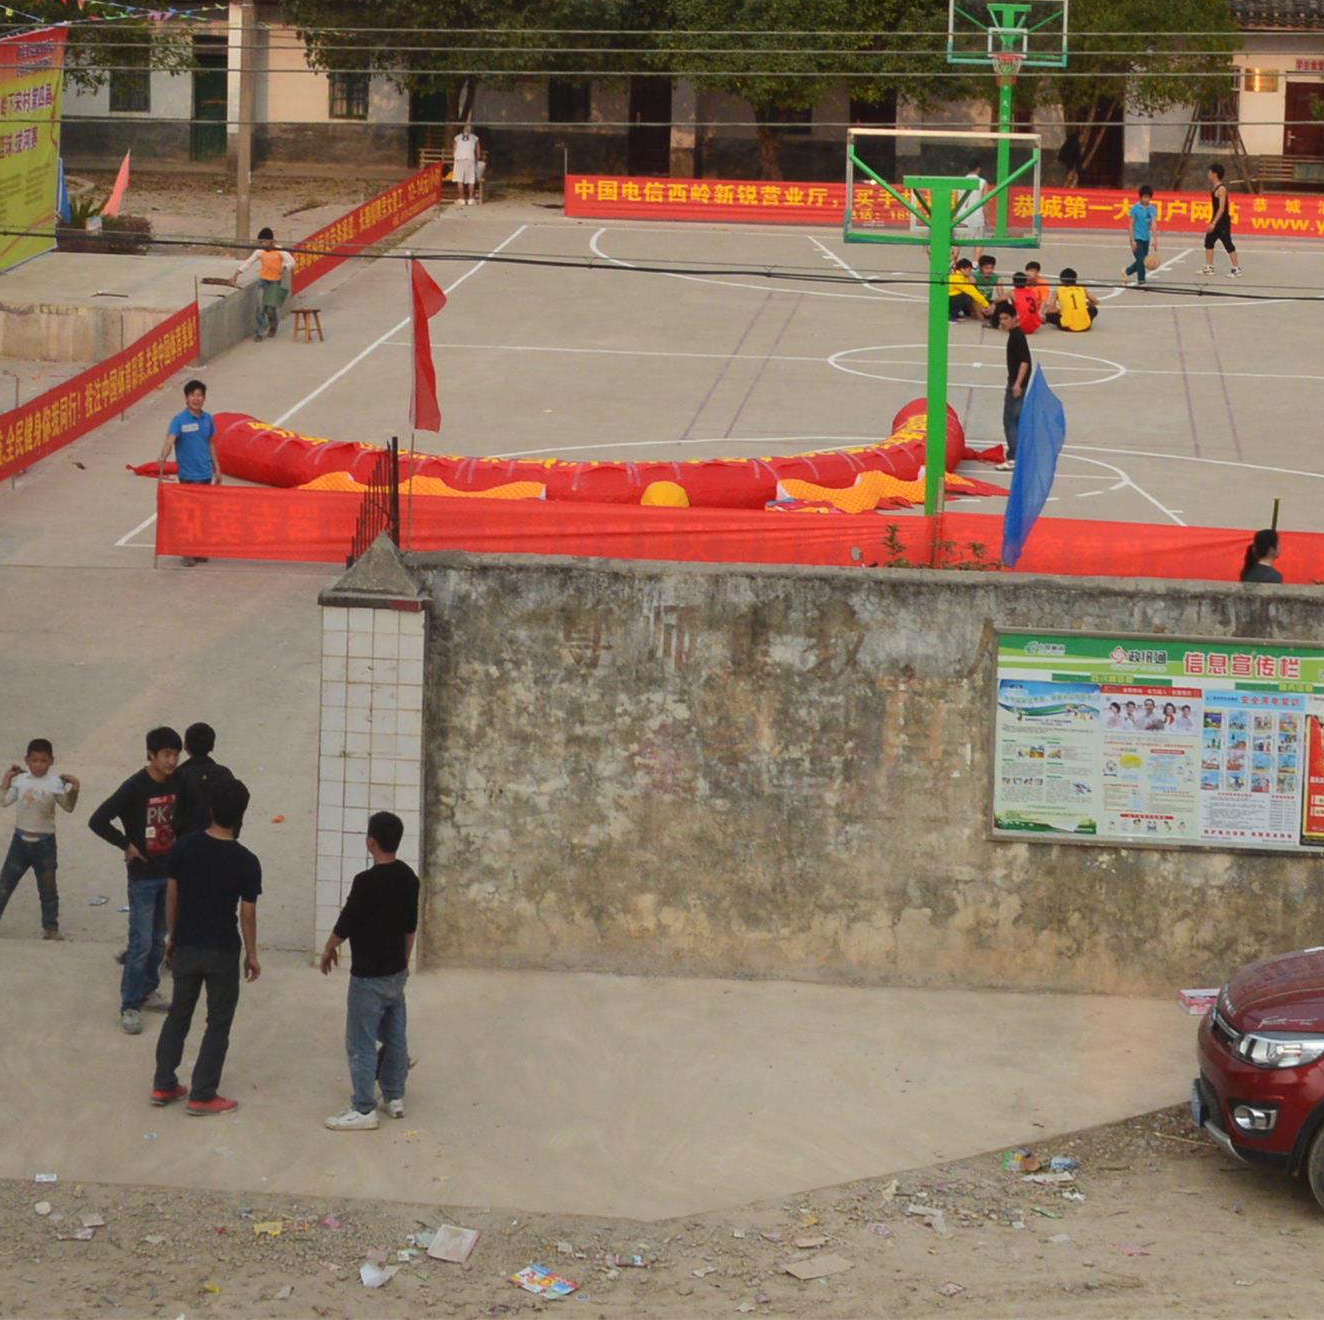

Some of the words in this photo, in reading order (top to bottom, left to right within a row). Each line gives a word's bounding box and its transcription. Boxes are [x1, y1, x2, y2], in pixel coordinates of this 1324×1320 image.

[1184, 652, 1301, 679] 信息宣传栏
